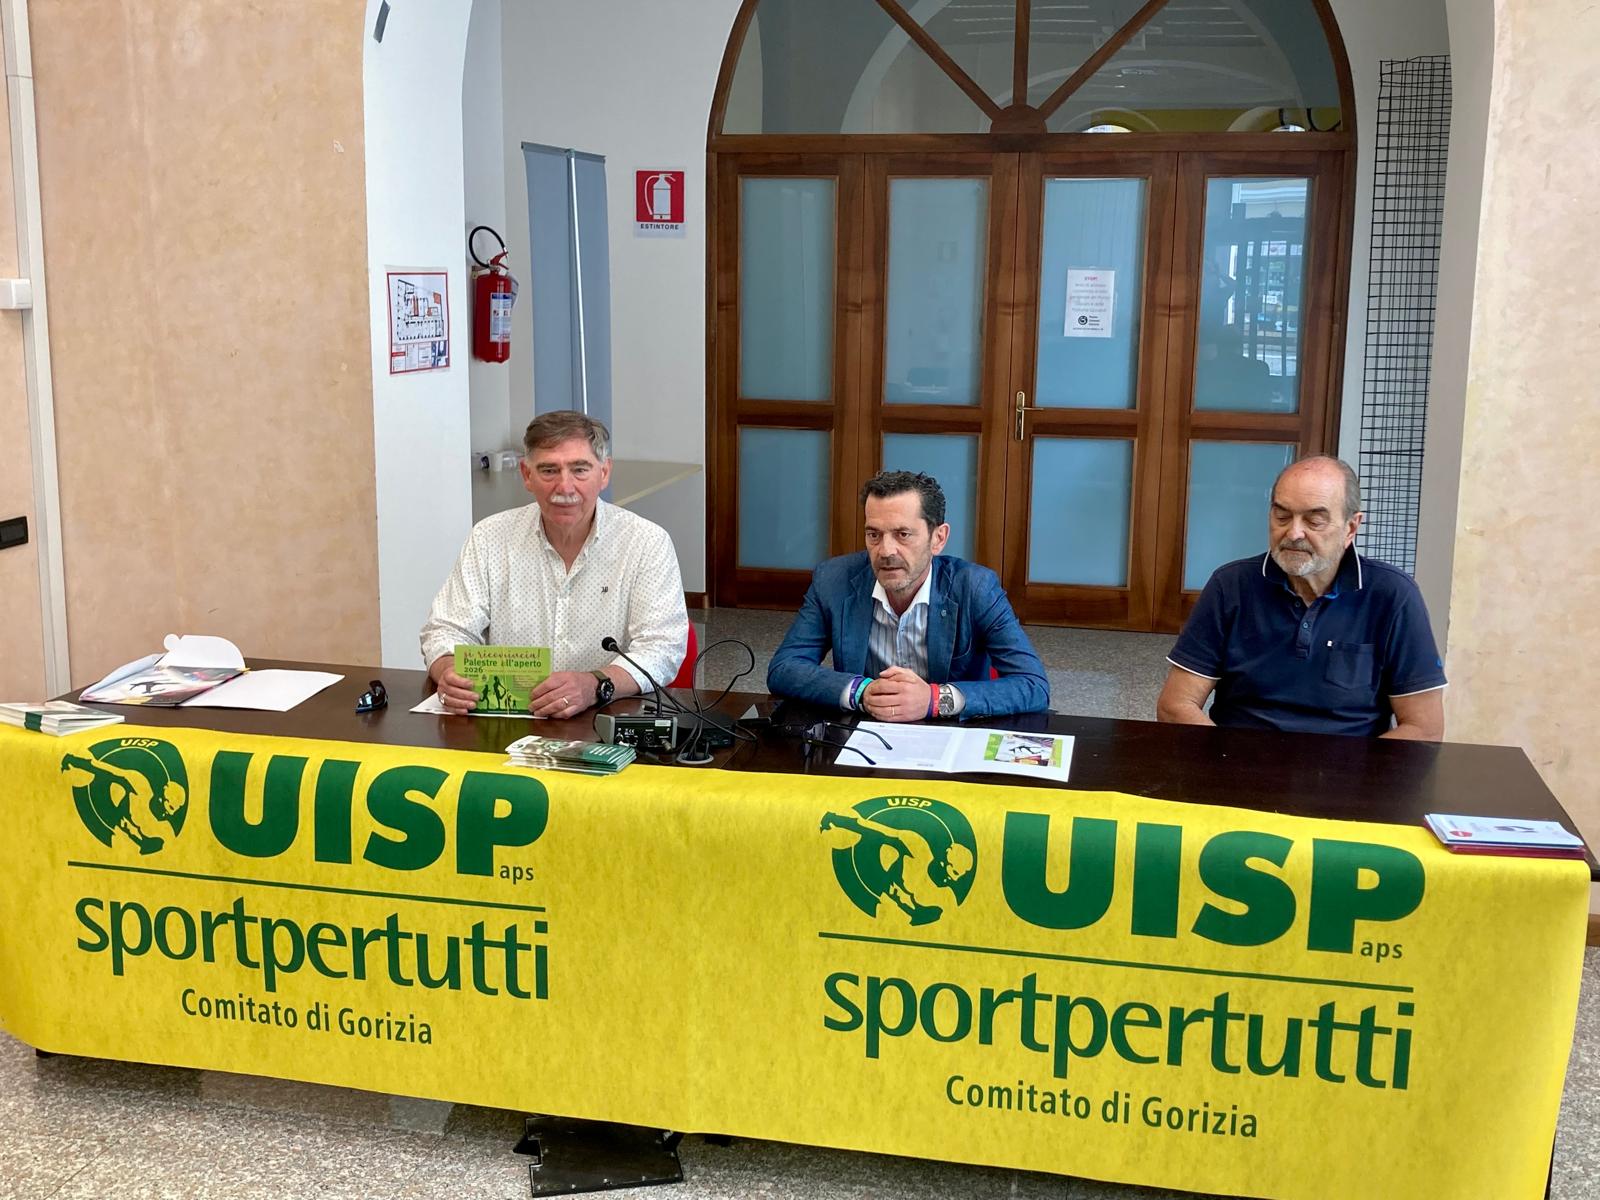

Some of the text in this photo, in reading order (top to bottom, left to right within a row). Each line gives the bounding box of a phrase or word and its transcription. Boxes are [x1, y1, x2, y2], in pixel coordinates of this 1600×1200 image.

[463, 658, 498, 667] Palestre
[463, 666, 484, 674] 2026
[120, 738, 160, 747] UISP
[209, 751, 549, 876] UISP
[886, 797, 932, 808] UISP
[500, 866, 534, 884] aps
[1002, 810, 1425, 954] UISP
[76, 897, 549, 1000] sportpertutti
[1361, 942, 1403, 964] aps
[182, 989, 433, 1045] Comitato di Gorizia
[824, 973, 1415, 1090] sportpertutti
[947, 1076, 1257, 1138] Comitato di Gorizia
